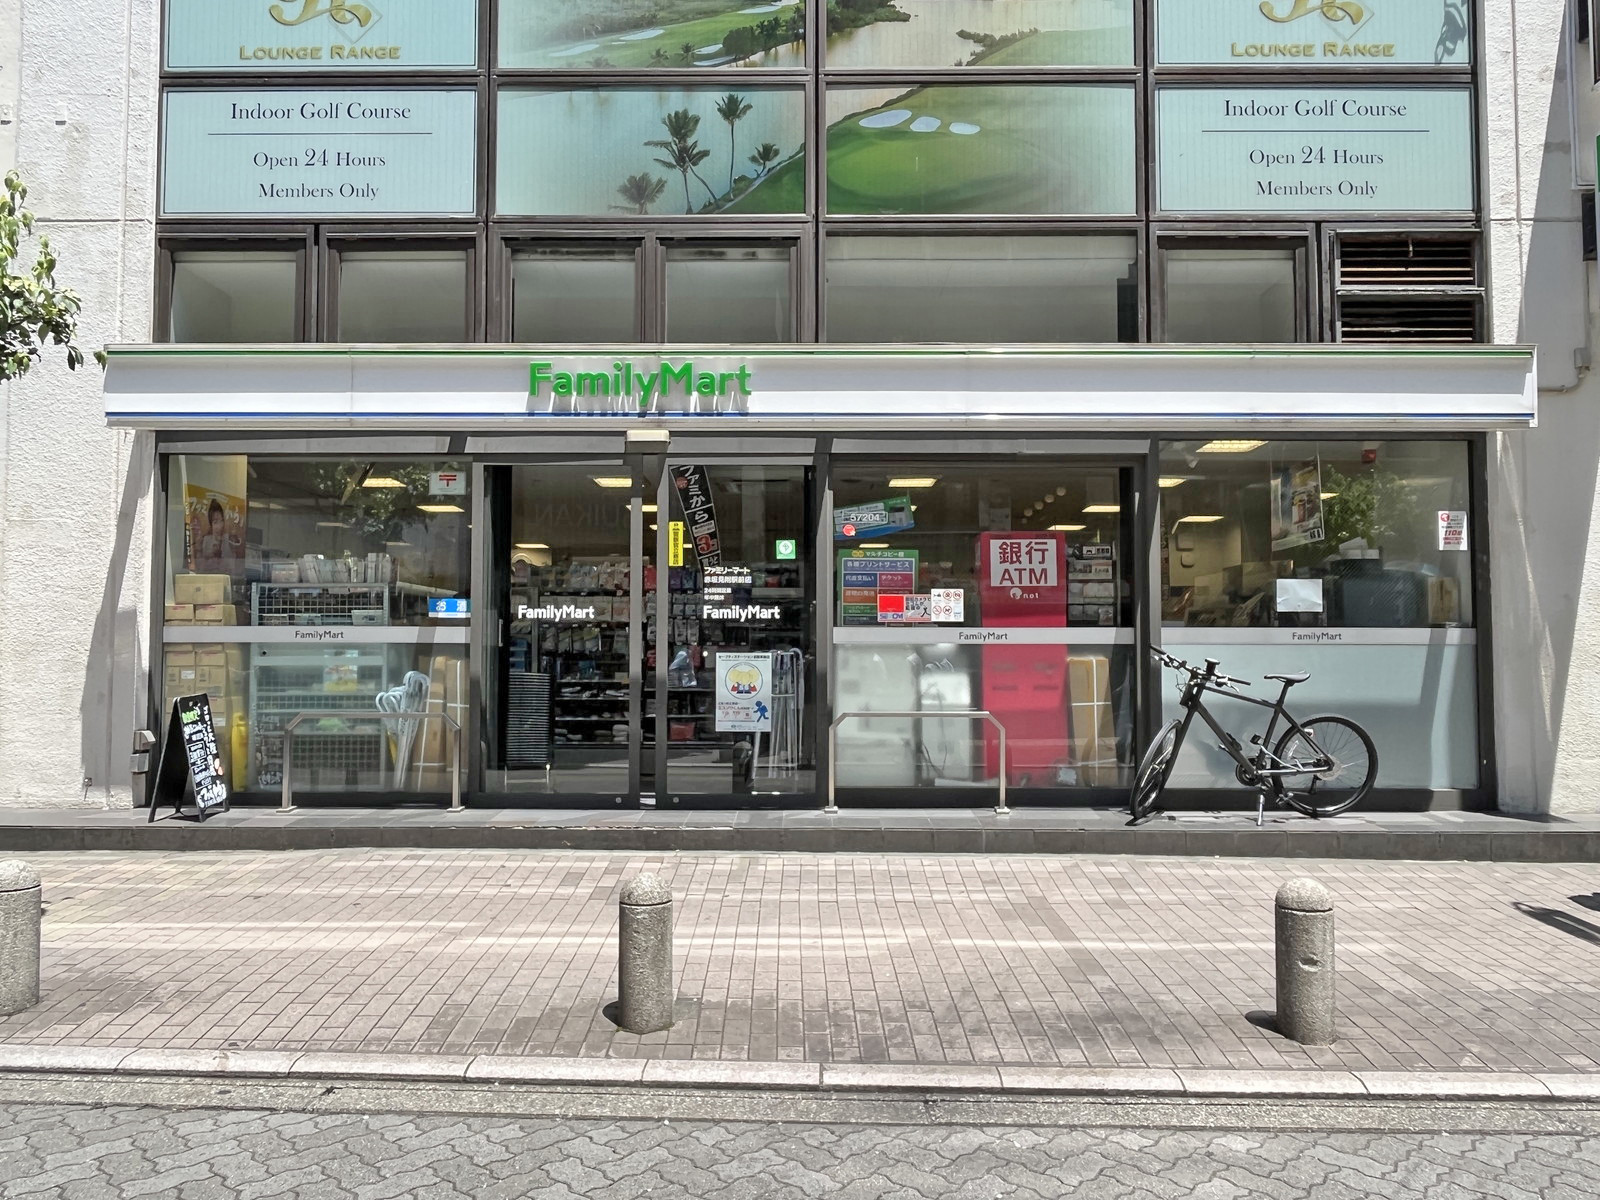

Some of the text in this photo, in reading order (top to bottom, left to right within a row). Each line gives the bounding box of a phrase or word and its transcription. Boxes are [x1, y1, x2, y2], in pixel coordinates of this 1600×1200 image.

[240, 45, 401, 60] LOUNGE RANGE
[1231, 42, 1395, 57] LOUNGE RANGE
[231, 102, 411, 120] Indoor Golf Course
[1224, 100, 1407, 117] Indoor Golf Course
[253, 148, 386, 169] Open 24 Hours
[1249, 146, 1384, 166] Open 24 Hours
[258, 183, 379, 201] Members Only
[1256, 181, 1378, 199] Members Only
[529, 361, 752, 407] FamilyMart
[999, 541, 1049, 565] 銀行
[704, 566, 751, 575] ファミリーマート
[999, 568, 1048, 585] ATM
[518, 605, 595, 622] FamilyMart
[703, 605, 780, 622] FamilyMart
[294, 630, 344, 641] FamilyMart
[959, 632, 1008, 643] FamilyMart
[1292, 632, 1342, 643] FamilyMart
